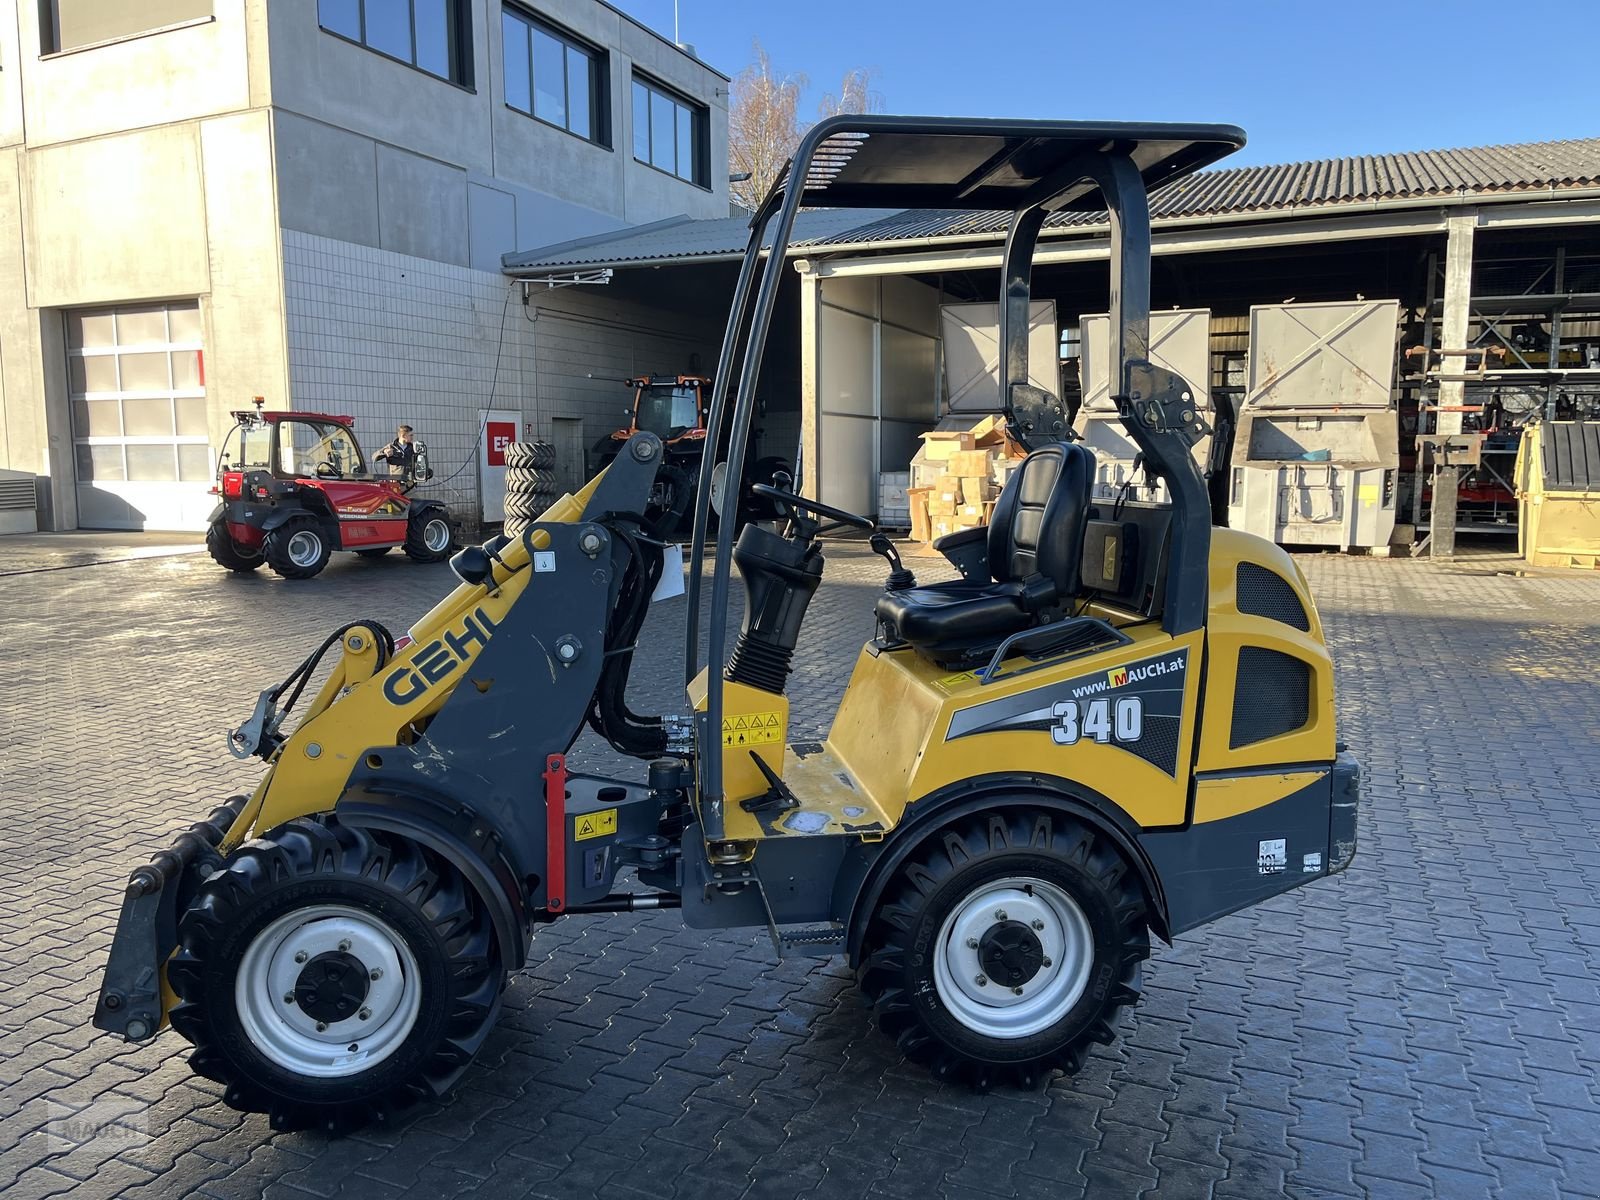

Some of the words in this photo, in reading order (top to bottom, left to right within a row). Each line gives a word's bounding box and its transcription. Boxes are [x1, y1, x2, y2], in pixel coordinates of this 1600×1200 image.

[382, 606, 502, 707] GEHL
[1072, 657, 1184, 698] www.MAUCH.at
[1051, 697, 1144, 745] 340
